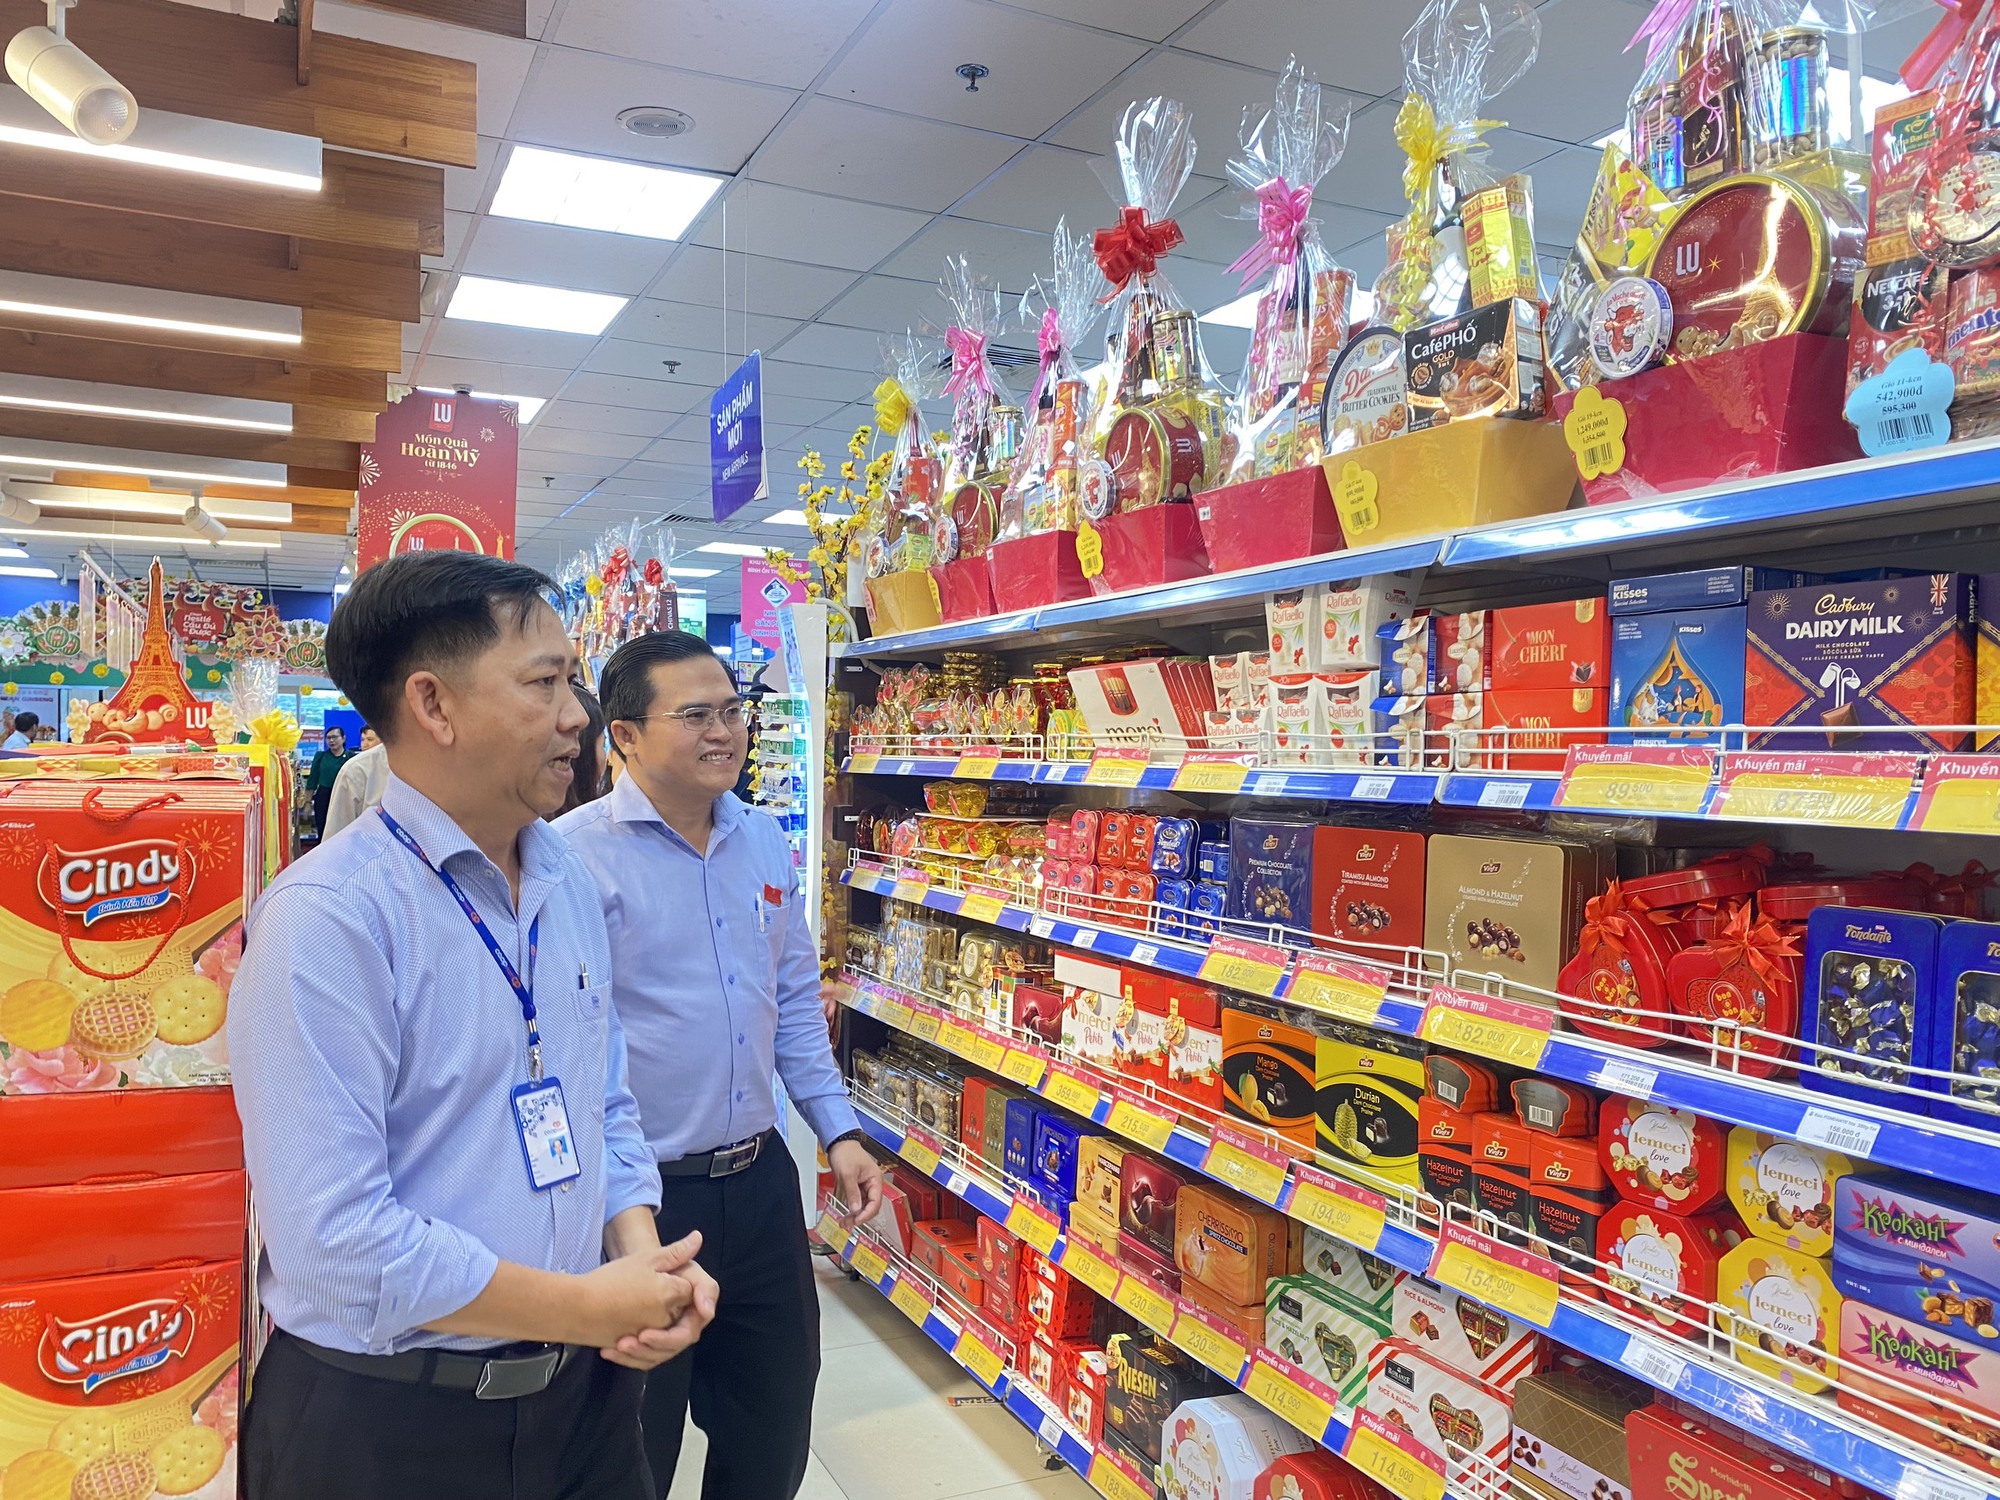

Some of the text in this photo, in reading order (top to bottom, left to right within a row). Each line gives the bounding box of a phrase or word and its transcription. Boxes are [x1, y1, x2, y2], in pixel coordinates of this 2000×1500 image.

[1676, 241, 1700, 276] LU
[1432, 350, 1454, 363] GOLD
[1367, 385, 1397, 396] TRADITIONAL
[434, 402, 451, 423] LU
[716, 381, 753, 435] SẢN PHẨM
[1342, 393, 1400, 414] BUTTER COOKIES
[414, 434, 468, 450] Món Quà
[728, 419, 744, 453] MỚI
[401, 442, 480, 467] Hoàn Mỹ
[731, 451, 749, 477] ARRIVALS
[436, 461, 457, 471] 1846
[1327, 593, 1362, 609] Raffaello
[1815, 594, 1875, 616] Cadbury
[1272, 610, 1304, 623] Raffaello
[1531, 629, 1555, 644] MON
[1786, 615, 1905, 640] DAIRY MILK
[1832, 641, 1870, 649] CHOCOLATE
[1214, 668, 1240, 681] Raffaello
[186, 707, 207, 729] LU
[1277, 705, 1309, 719] Raffaello
[1328, 705, 1363, 719] Raffaello
[1574, 751, 1632, 764] Khuyến mãi
[1734, 758, 1807, 772] Khuyến mãi
[1249, 858, 1293, 870] PREMIUM CHOCOLATE
[1257, 866, 1282, 876] COLLECTION
[60, 849, 180, 904] Cindy
[1341, 870, 1389, 884] TIRAMISU ALMOND
[1458, 885, 1485, 897] ALMOND
[1491, 889, 1524, 902] HAZELNUT
[1845, 924, 1892, 944] Fondante
[1434, 991, 1488, 1013] Khuyến mãi
[1078, 1012, 1111, 1032] merci
[1084, 1028, 1103, 1046] Petits
[1137, 1031, 1153, 1045] Petits
[1256, 1056, 1278, 1072] Mango
[1355, 1087, 1380, 1105] Durian
[1216, 1128, 1246, 1149] Khuyến mãi
[1633, 1130, 1687, 1156] lemeci
[1650, 1149, 1670, 1164] love
[1426, 1158, 1464, 1178] Hazelnut
[1762, 1163, 1819, 1191] lemeci
[1300, 1168, 1337, 1191] Khuyến mãi
[1479, 1179, 1517, 1200] Hazelnut
[1780, 1183, 1801, 1200] love
[1538, 1201, 1581, 1224] Hazelnut
[1197, 1210, 1244, 1244] CHERRISSIMO
[1447, 1226, 1492, 1254] Khuyến mãi
[1904, 1238, 1948, 1260] миндалем
[1626, 1255, 1676, 1284] lemeci
[1403, 1288, 1416, 1299] RICE
[1421, 1297, 1446, 1314] ALMOND
[1755, 1296, 1813, 1327] lemeci
[1286, 1326, 1310, 1342] HAZELNUT
[1773, 1316, 1794, 1334] love
[56, 1309, 182, 1374] Cindy
[1256, 1348, 1290, 1375] Khuyến mãi
[1117, 1358, 1157, 1399] RIESEN
[1913, 1364, 1959, 1390] миндалем
[1377, 1384, 1390, 1395] RICE
[1395, 1393, 1420, 1413] ALMOND
[1360, 1412, 1401, 1443] Khuyến mãi
[1178, 1456, 1212, 1494] lemeci
[1548, 1470, 1589, 1500] Assortiment
[1709, 1465, 1752, 1496] Morbidelli
